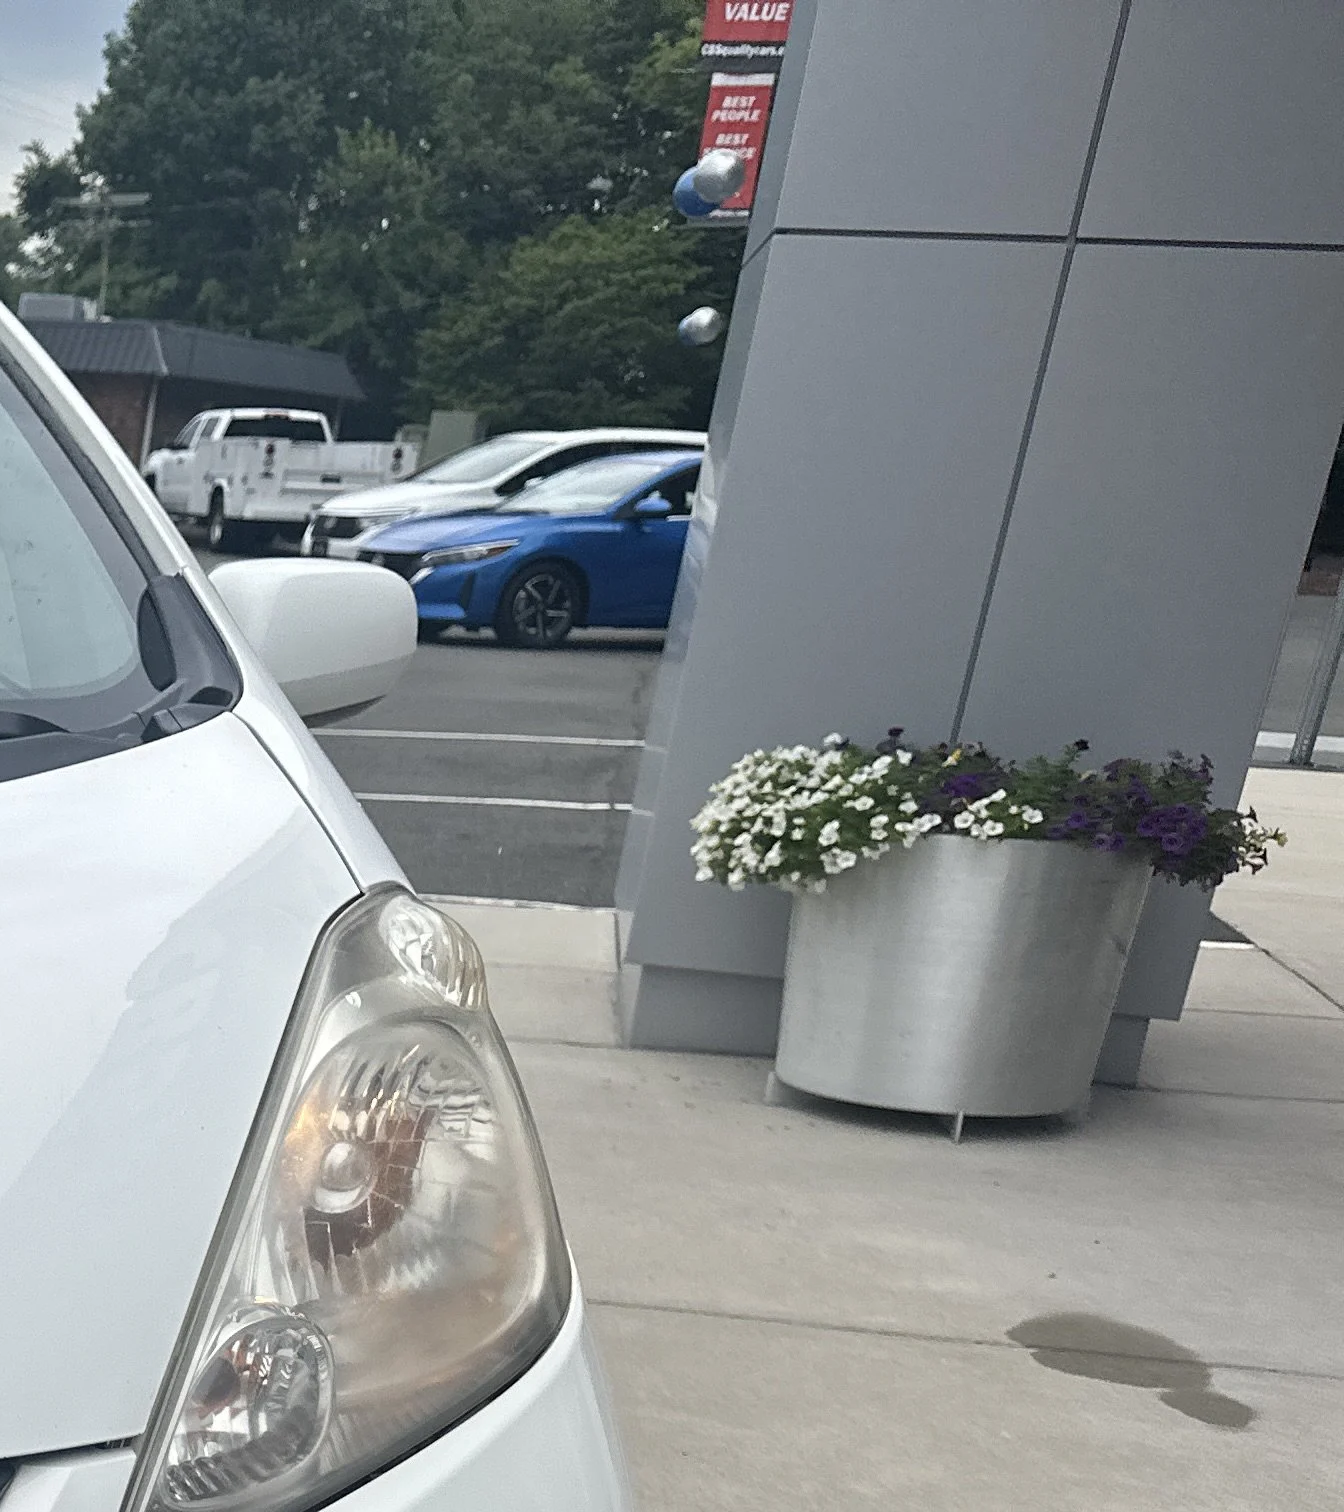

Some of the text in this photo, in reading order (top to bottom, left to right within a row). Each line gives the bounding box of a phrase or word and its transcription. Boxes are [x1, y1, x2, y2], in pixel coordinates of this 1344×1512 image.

[724, 2, 789, 22] VALUE
[721, 95, 756, 109] BEST
[712, 109, 761, 123] PEOPLE
[715, 133, 750, 146] BEST
